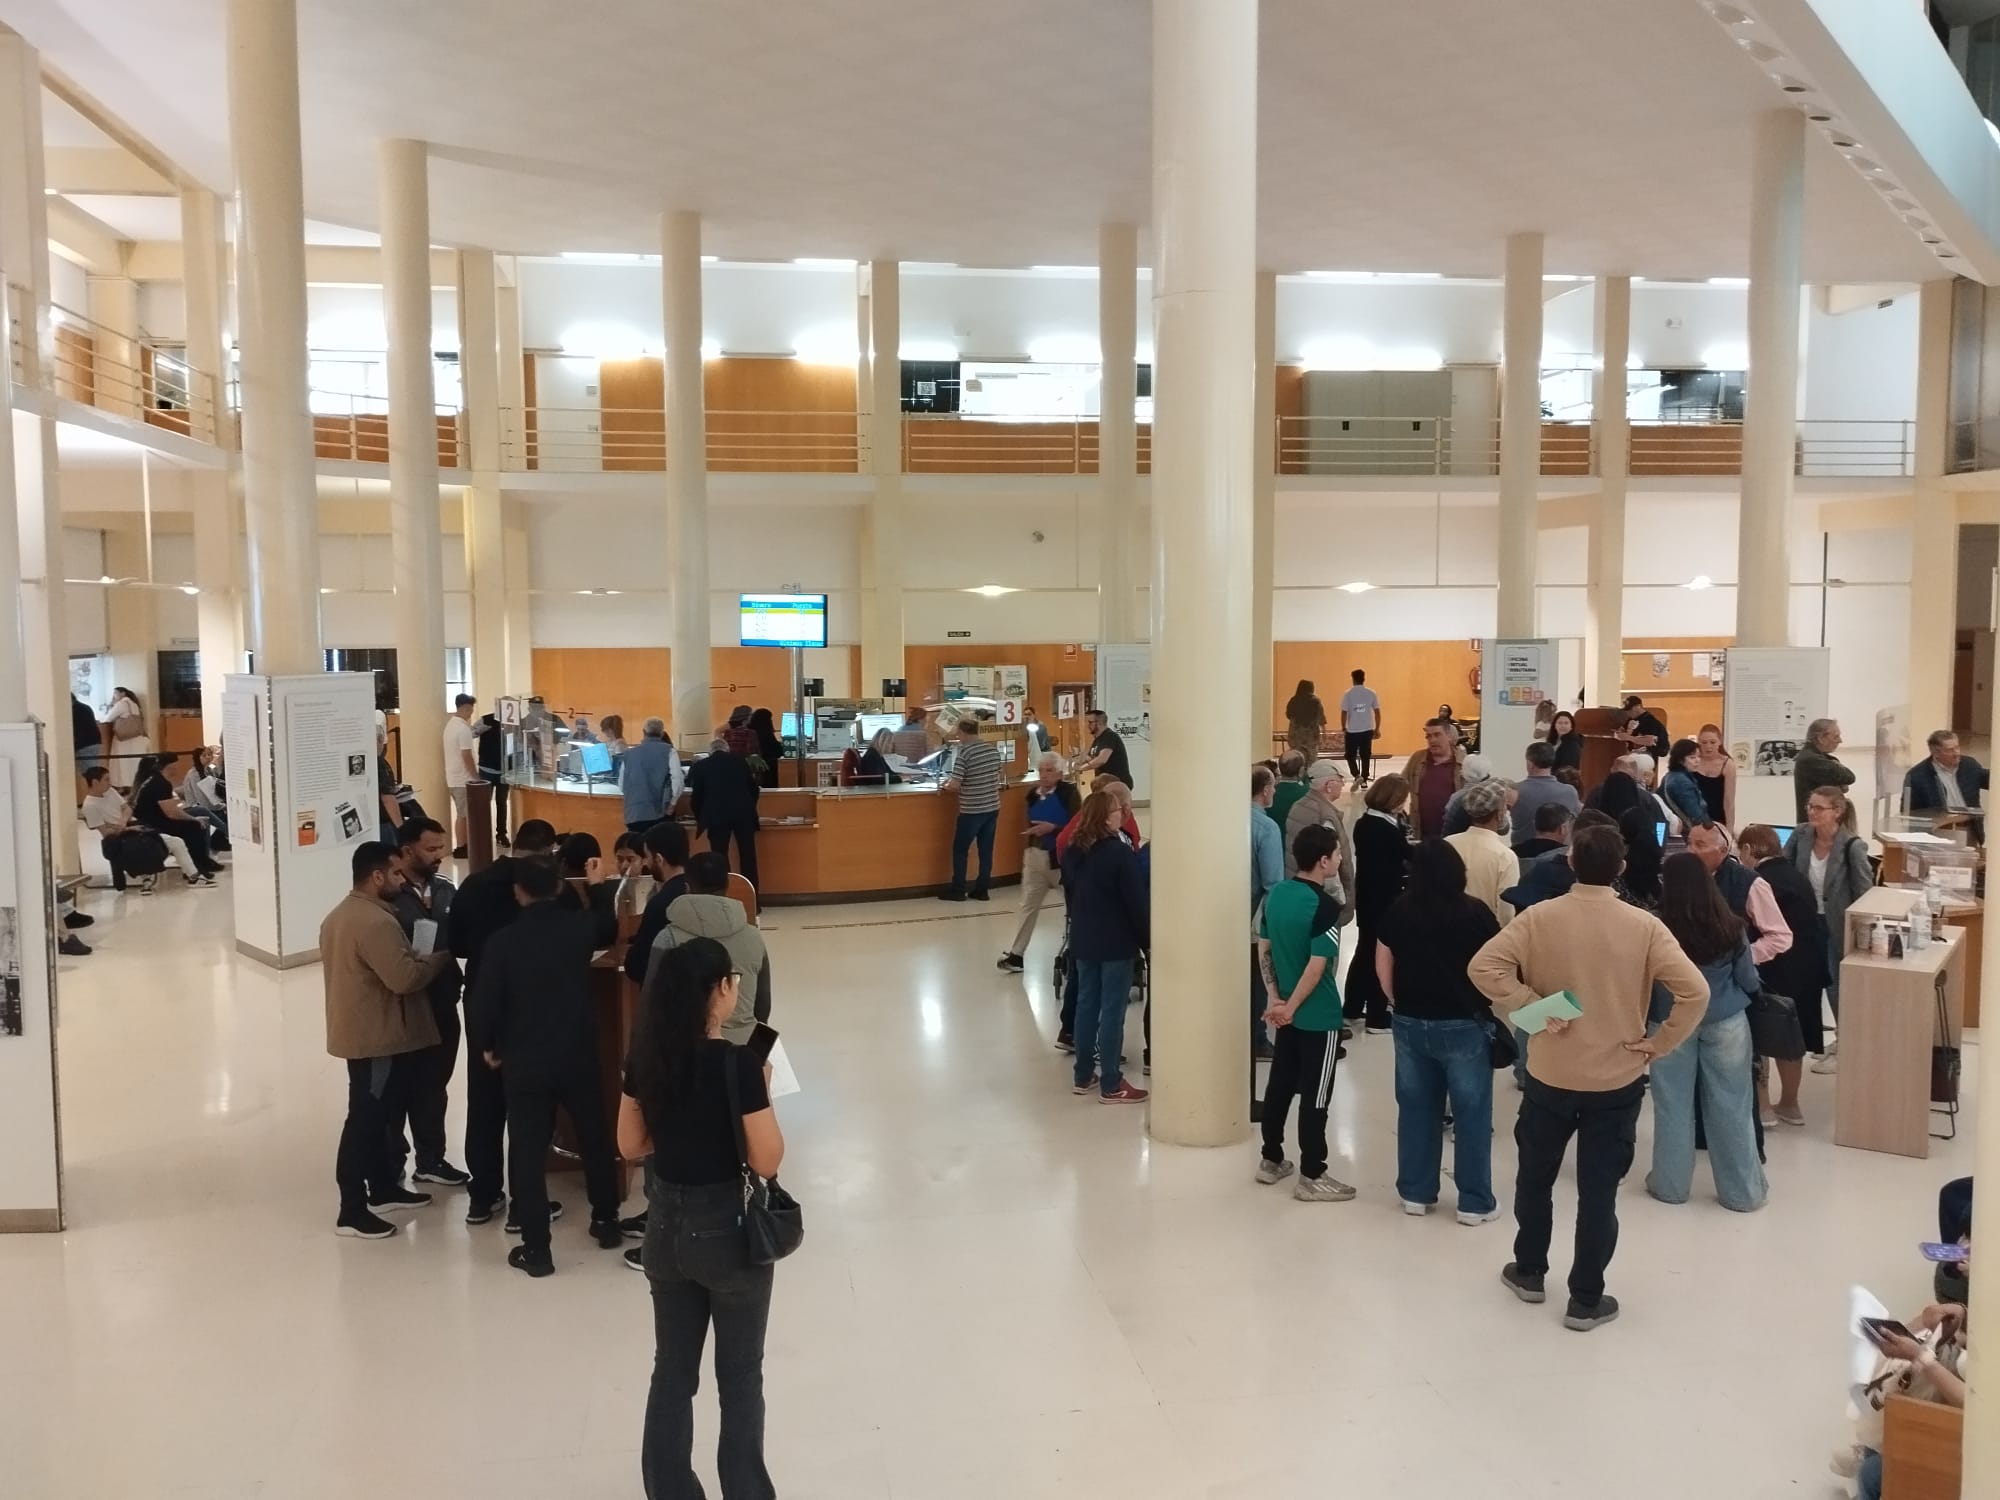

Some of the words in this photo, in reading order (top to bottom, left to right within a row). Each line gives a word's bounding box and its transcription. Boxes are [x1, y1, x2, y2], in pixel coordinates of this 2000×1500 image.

[506, 703, 514, 723] 2
[568, 707, 574, 719] 2
[1003, 701, 1015, 722] 3
[1062, 697, 1070, 716] 4
